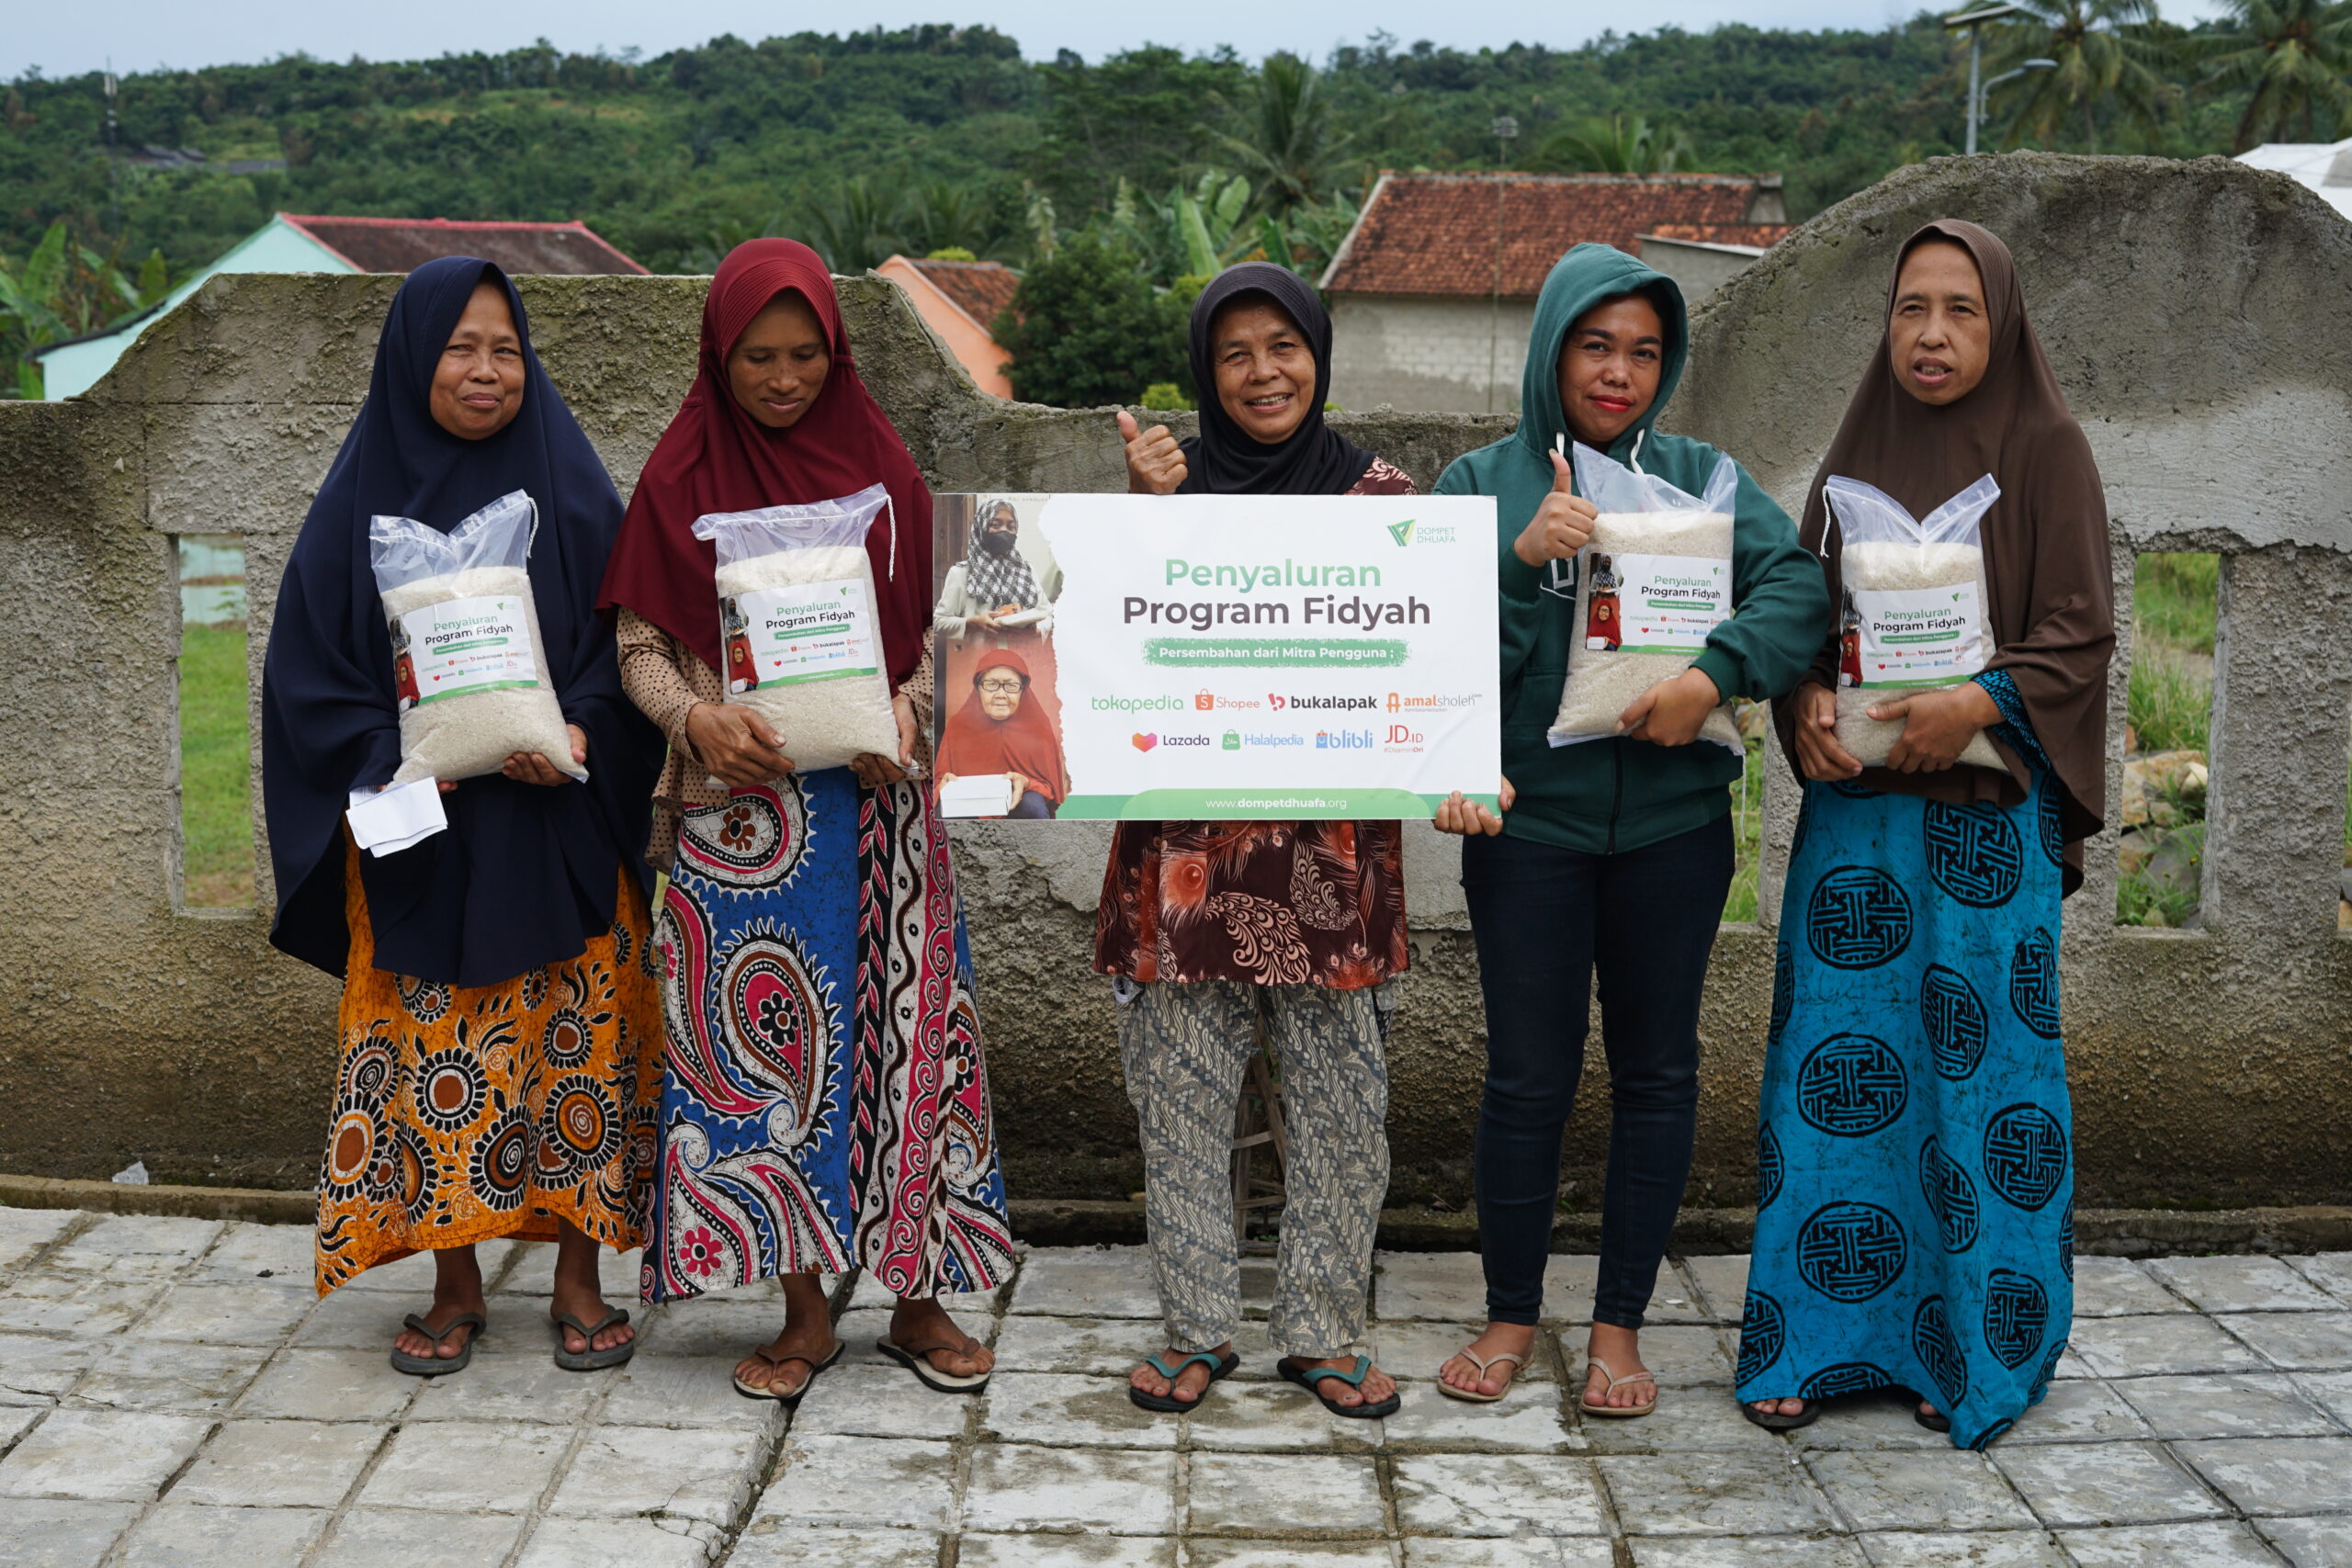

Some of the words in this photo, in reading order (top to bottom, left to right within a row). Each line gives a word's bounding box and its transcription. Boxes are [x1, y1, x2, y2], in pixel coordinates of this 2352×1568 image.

[1165, 558, 1382, 593] Penyaluran
[1654, 575, 1713, 588] Penyaluran
[1641, 586, 1690, 598] Program
[1691, 588, 1721, 601] Fidyah
[776, 601, 842, 616] Penyaluran
[1124, 596, 1290, 631] Program
[1304, 594, 1430, 631] Fidyah
[1884, 608, 1951, 622] Penyaluran
[434, 615, 498, 632] Penyaluran
[765, 615, 817, 629] Program
[820, 610, 855, 622] Fidyah
[1873, 622, 1924, 634] Program
[1928, 615, 1966, 629] Fidyah
[425, 629, 473, 646] Program
[476, 624, 514, 636] Fidyah
[1159, 648, 1250, 659] Persembahan
[1253, 647, 1279, 659] dari
[1283, 648, 1316, 659] Mitra
[1319, 648, 1387, 660] Pengguna
[1091, 694, 1184, 715] tokopedia
[1216, 696, 1261, 712] Shopee
[1291, 695, 1378, 712] bukalapak
[1163, 735, 1210, 746] Lazada
[1244, 734, 1304, 748] Halalpedia
[1329, 729, 1374, 749] blibli
[1205, 798, 1347, 810] www.dompetdhuafa.org
